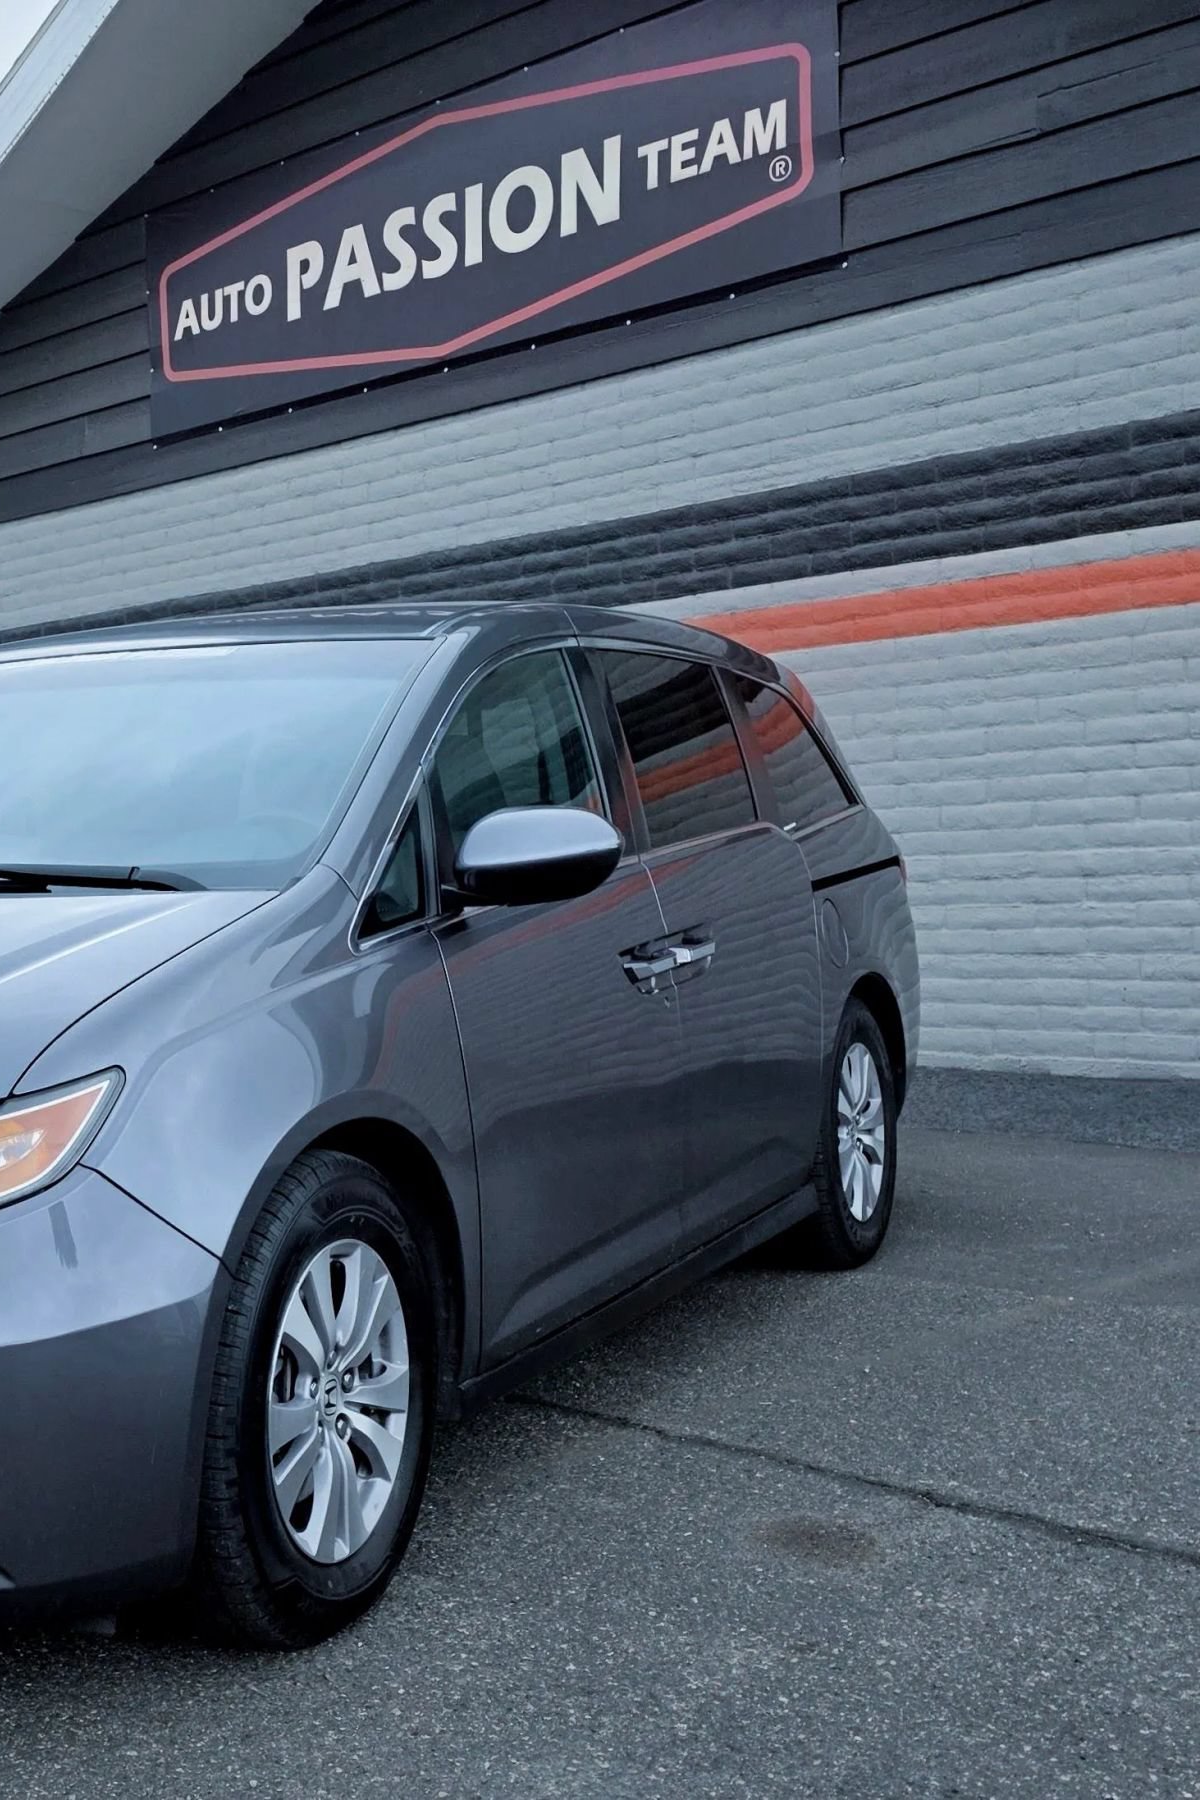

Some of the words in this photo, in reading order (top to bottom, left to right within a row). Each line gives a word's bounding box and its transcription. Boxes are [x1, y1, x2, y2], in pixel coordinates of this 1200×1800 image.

[174, 273, 273, 341] AUTO
[286, 134, 621, 322] PASSION
[638, 98, 787, 191] TEAM
